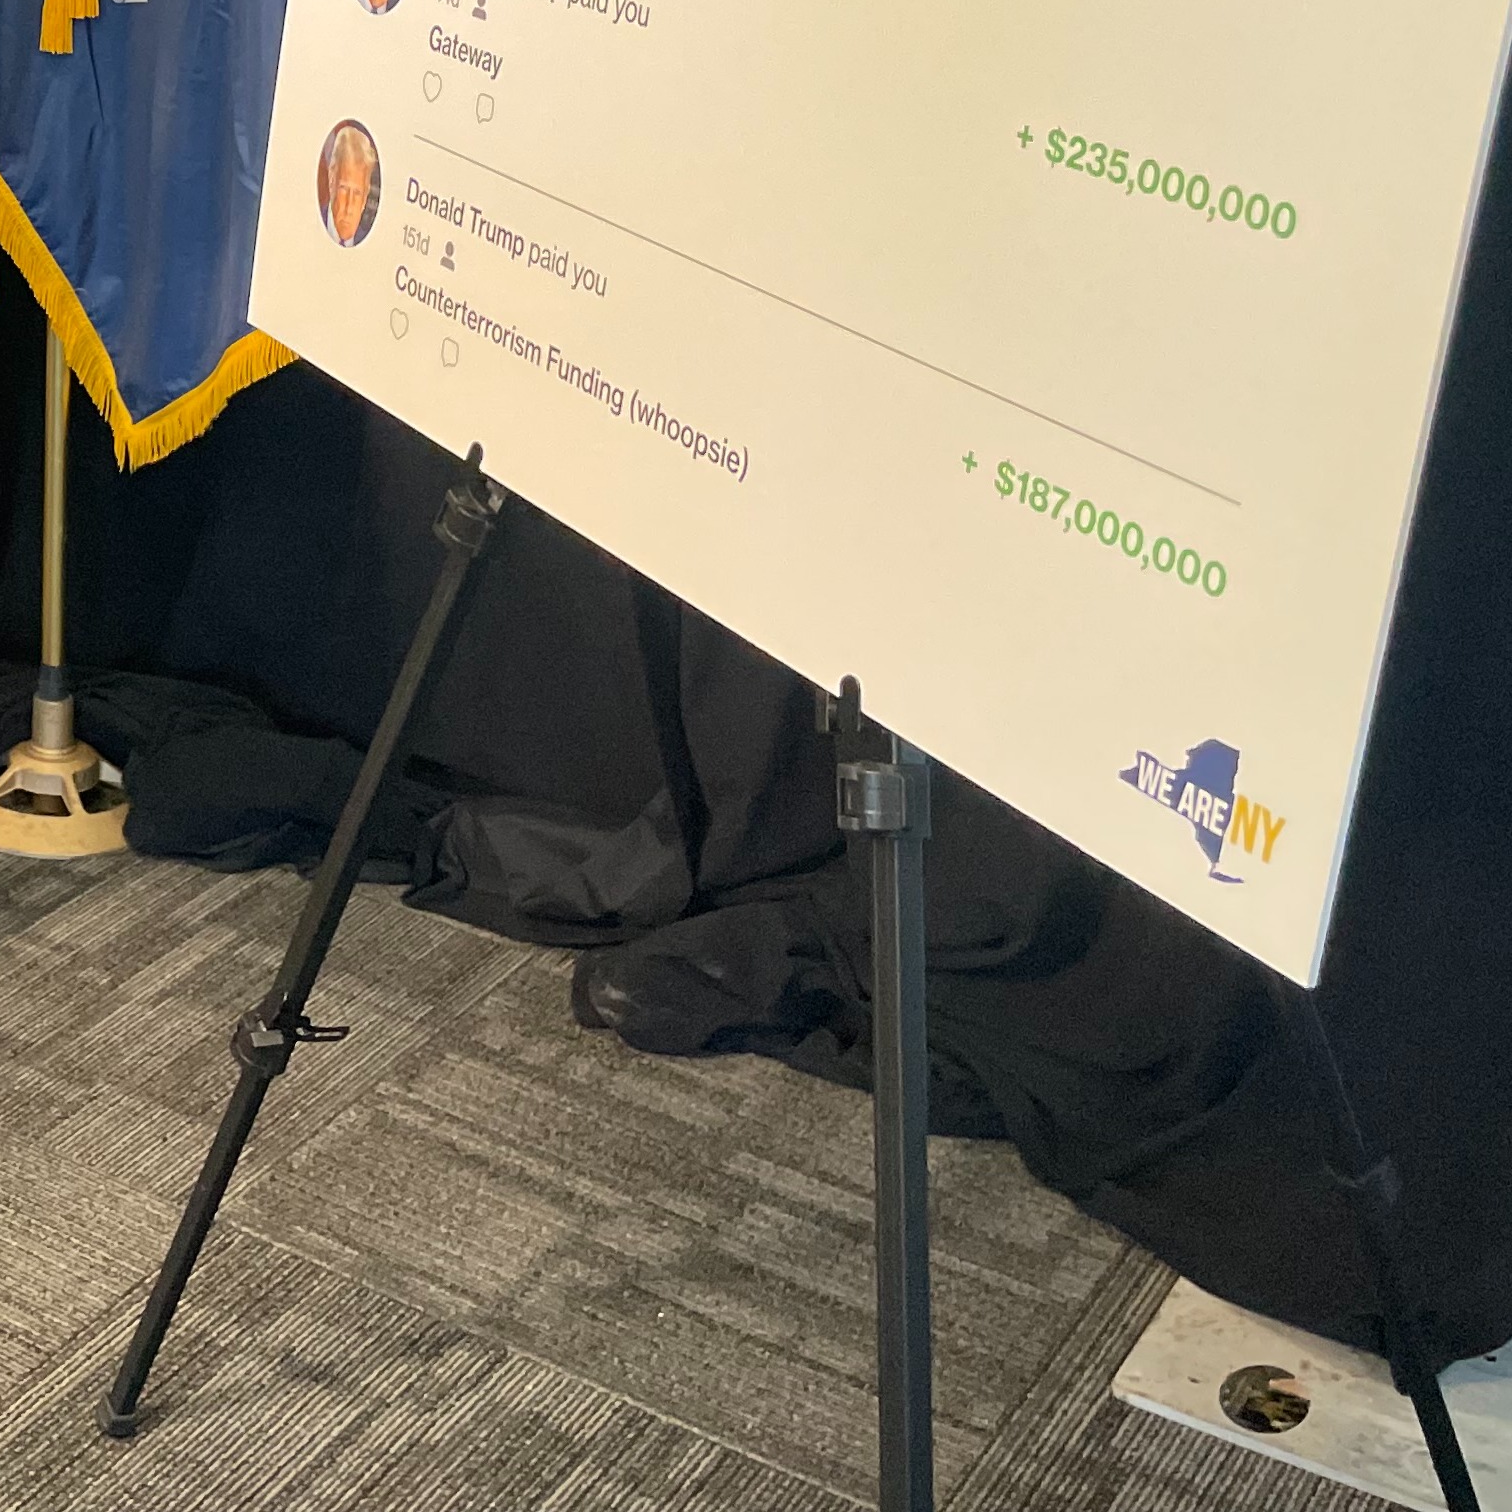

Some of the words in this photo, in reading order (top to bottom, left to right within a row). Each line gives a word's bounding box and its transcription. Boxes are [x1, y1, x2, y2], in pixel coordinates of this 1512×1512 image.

[429, 24, 503, 80] Gateway
[406, 177, 465, 227] Donald
[469, 206, 524, 259] Trump
[527, 241, 568, 279] paid
[571, 261, 608, 297] you
[1044, 127, 1297, 239] $235,000,000
[402, 224, 431, 256] 151d
[395, 265, 541, 366] Counterterrorism
[546, 344, 624, 416] Funding
[629, 389, 749, 483] (whoopsie)
[993, 459, 1227, 597] $187,000,000
[1138, 755, 1176, 805] WE
[1177, 781, 1228, 837] ARE
[1229, 794, 1286, 864] NY
